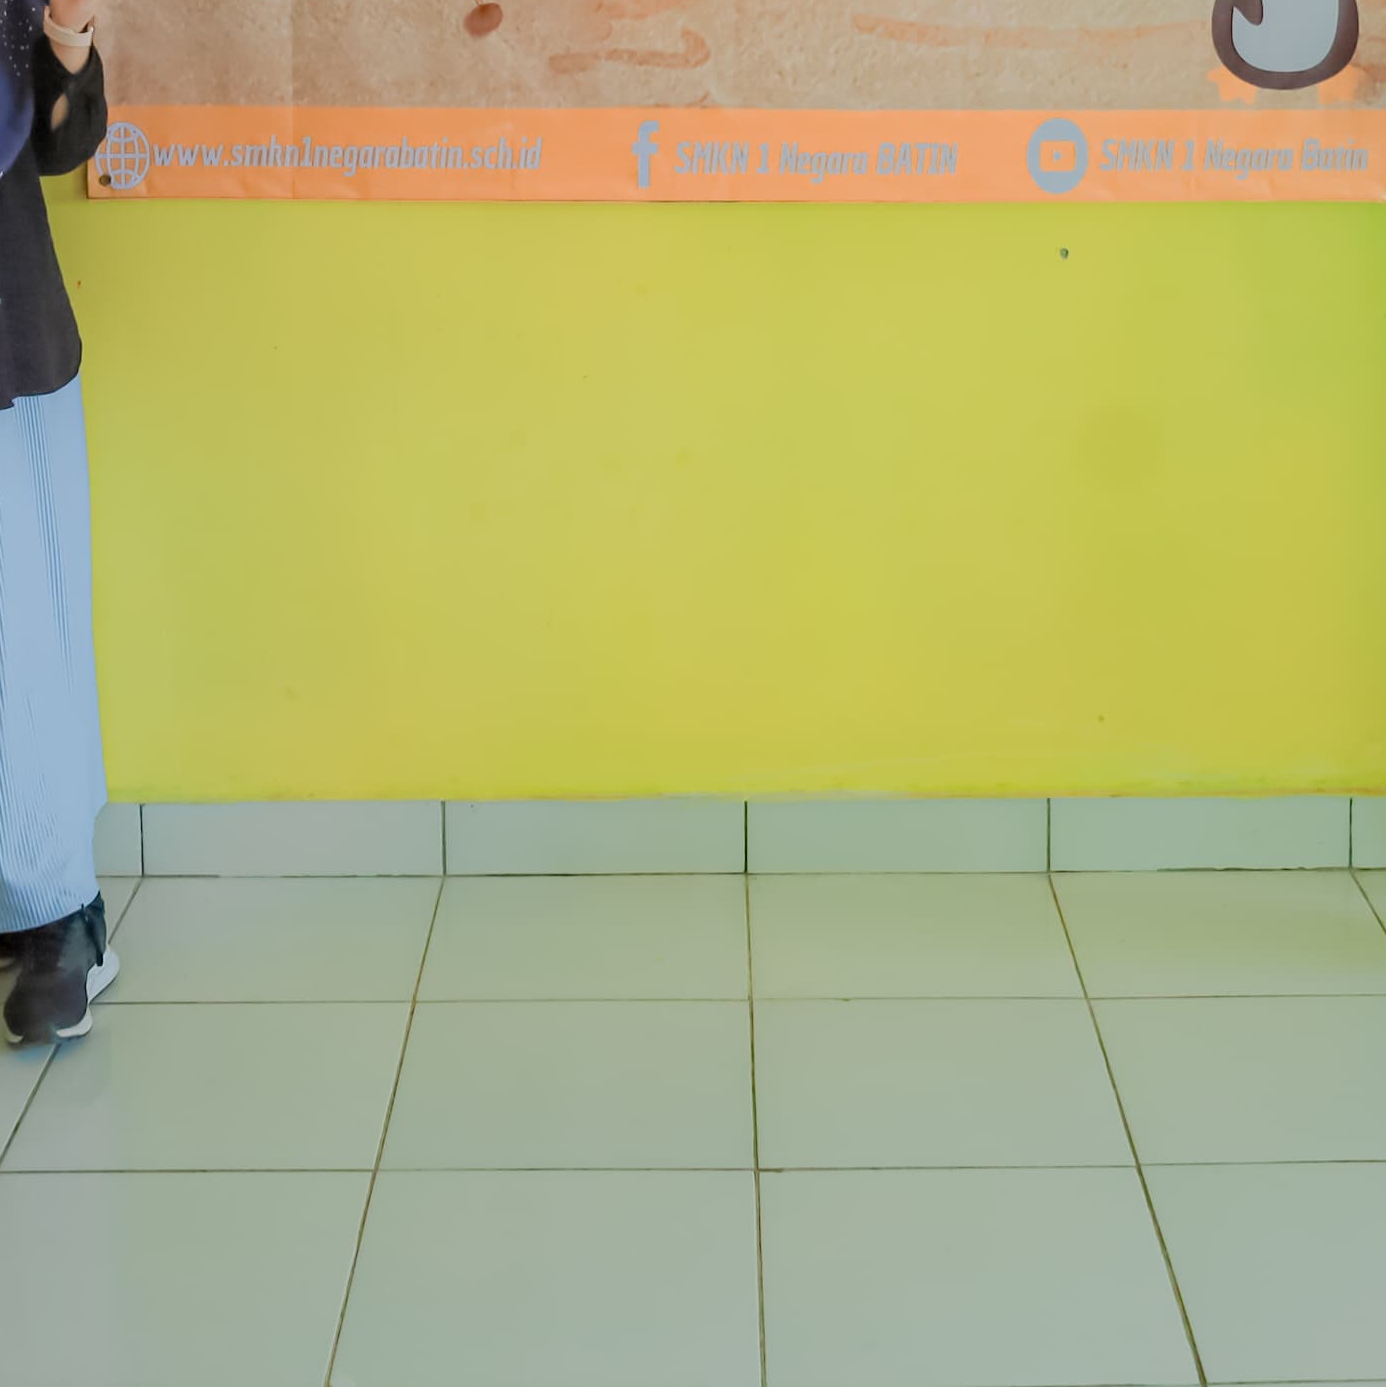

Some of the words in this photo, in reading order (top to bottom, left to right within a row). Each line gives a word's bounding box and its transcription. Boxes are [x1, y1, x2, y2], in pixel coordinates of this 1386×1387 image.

[153, 135, 542, 176] www.smkn1negarabatin.sch.id
[675, 141, 748, 174] SMKN
[757, 143, 769, 173] 1
[780, 142, 868, 183] Negara
[877, 142, 958, 174] BATIN
[1099, 139, 1175, 171] SMKN
[1181, 140, 1194, 170] 1
[1205, 140, 1293, 180] Negara
[1301, 138, 1369, 171] Batin
